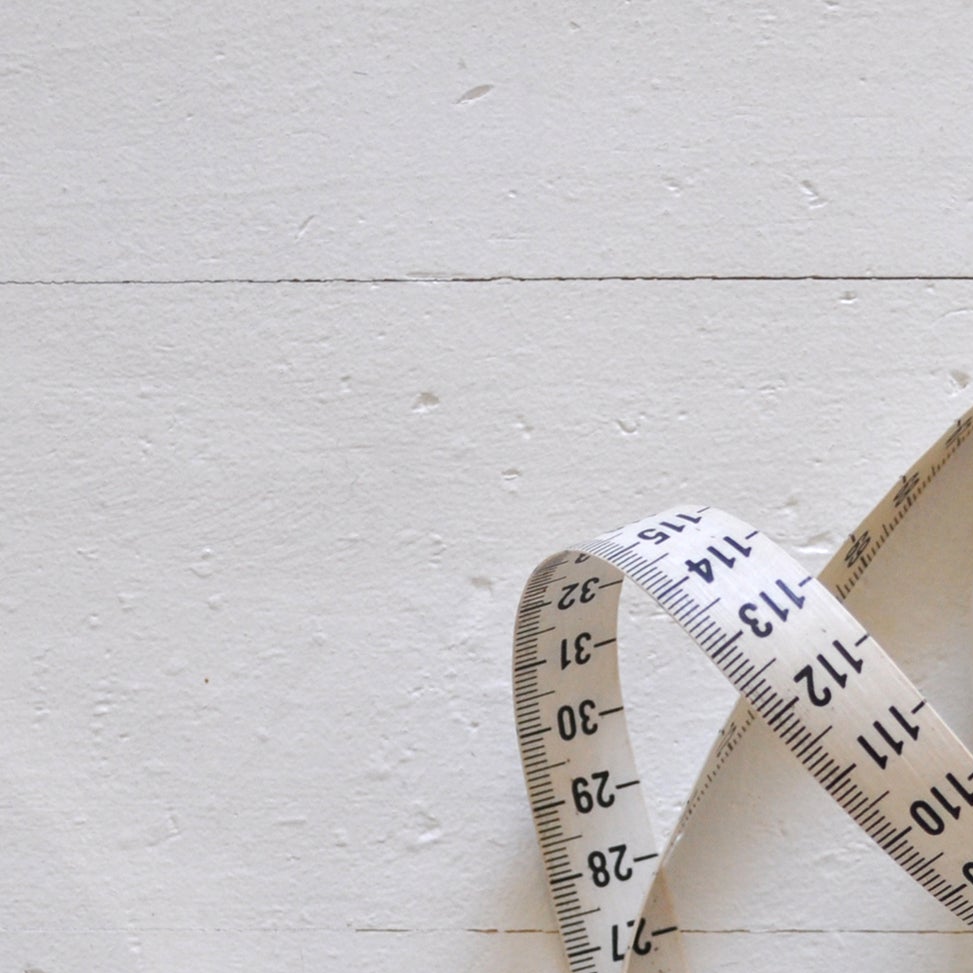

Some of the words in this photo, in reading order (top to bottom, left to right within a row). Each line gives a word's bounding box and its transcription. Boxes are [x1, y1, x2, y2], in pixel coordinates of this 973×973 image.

[638, 513, 702, 545] 115
[685, 535, 752, 583] 114
[558, 577, 599, 610] 32
[738, 579, 806, 637] 113
[560, 632, 592, 670] 31
[794, 640, 864, 707] 112
[557, 699, 598, 740] 30
[857, 706, 920, 770] 111
[571, 770, 616, 814] 29
[587, 844, 633, 887] 28
[611, 918, 652, 962] 27
